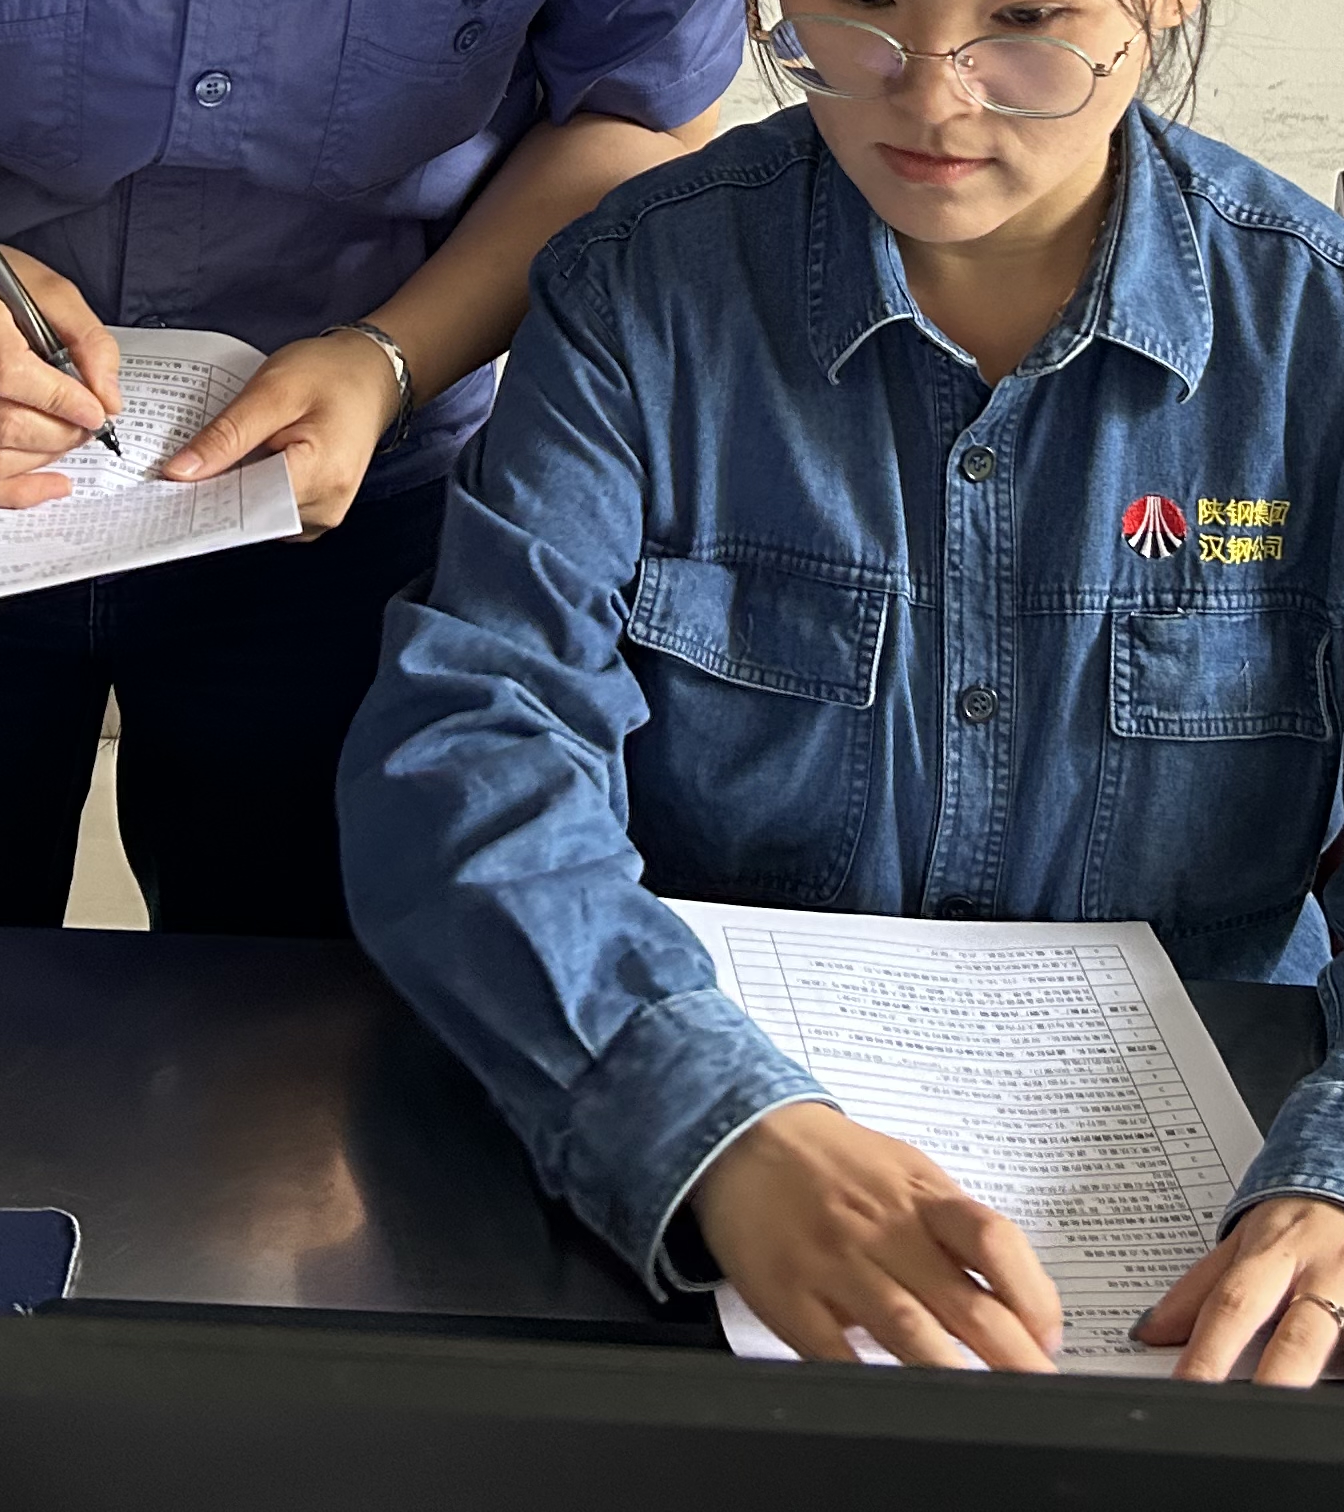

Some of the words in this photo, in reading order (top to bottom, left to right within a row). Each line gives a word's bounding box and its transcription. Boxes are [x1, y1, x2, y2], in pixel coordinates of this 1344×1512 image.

[1198, 498, 1290, 526] 陕钢集团
[1199, 533, 1283, 565] 汉钢公司
